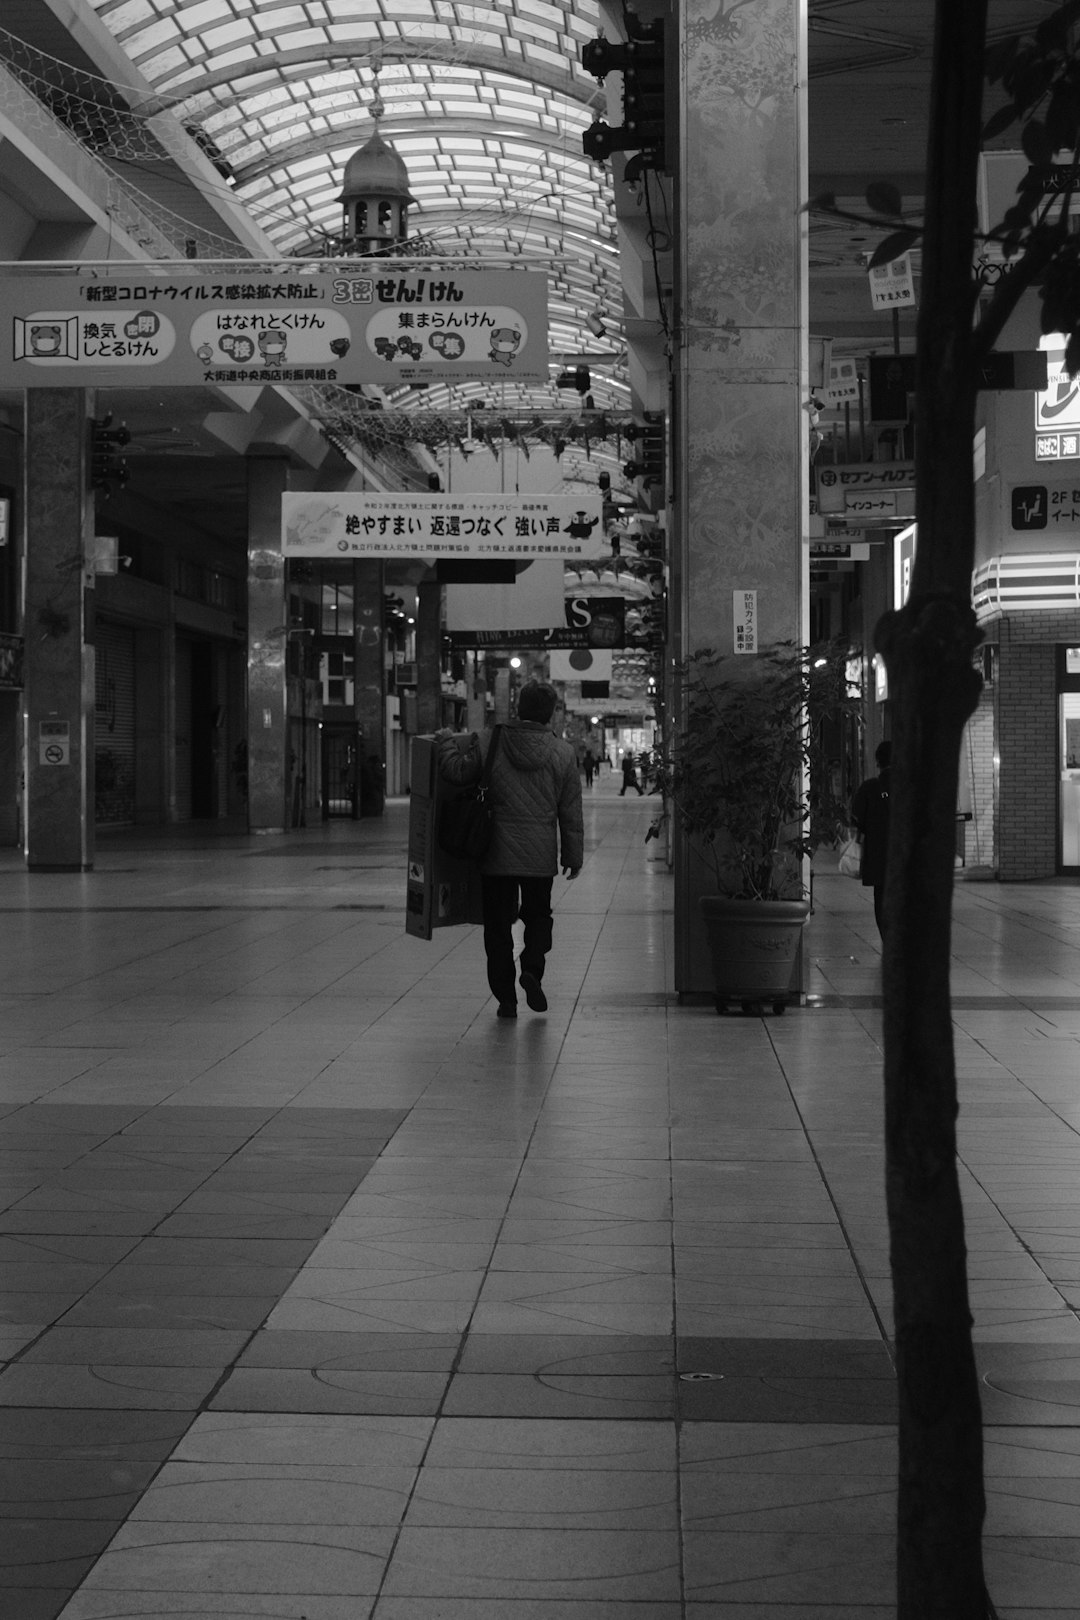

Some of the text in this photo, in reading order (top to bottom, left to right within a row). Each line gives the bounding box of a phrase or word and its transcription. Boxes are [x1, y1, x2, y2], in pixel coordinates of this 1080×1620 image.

[217, 314, 325, 330] はなれとくけん
[398, 312, 496, 328] 集まらんけん
[83, 323, 117, 339] 換気
[84, 342, 159, 357] しとるけん
[204, 369, 338, 382] 大街道中央商店街振興組合
[1037, 436, 1077, 456] たばこ 酒
[1052, 491, 1069, 504] 2F
[345, 514, 560, 537] 絶やすまい 返還つなぐ 強い声
